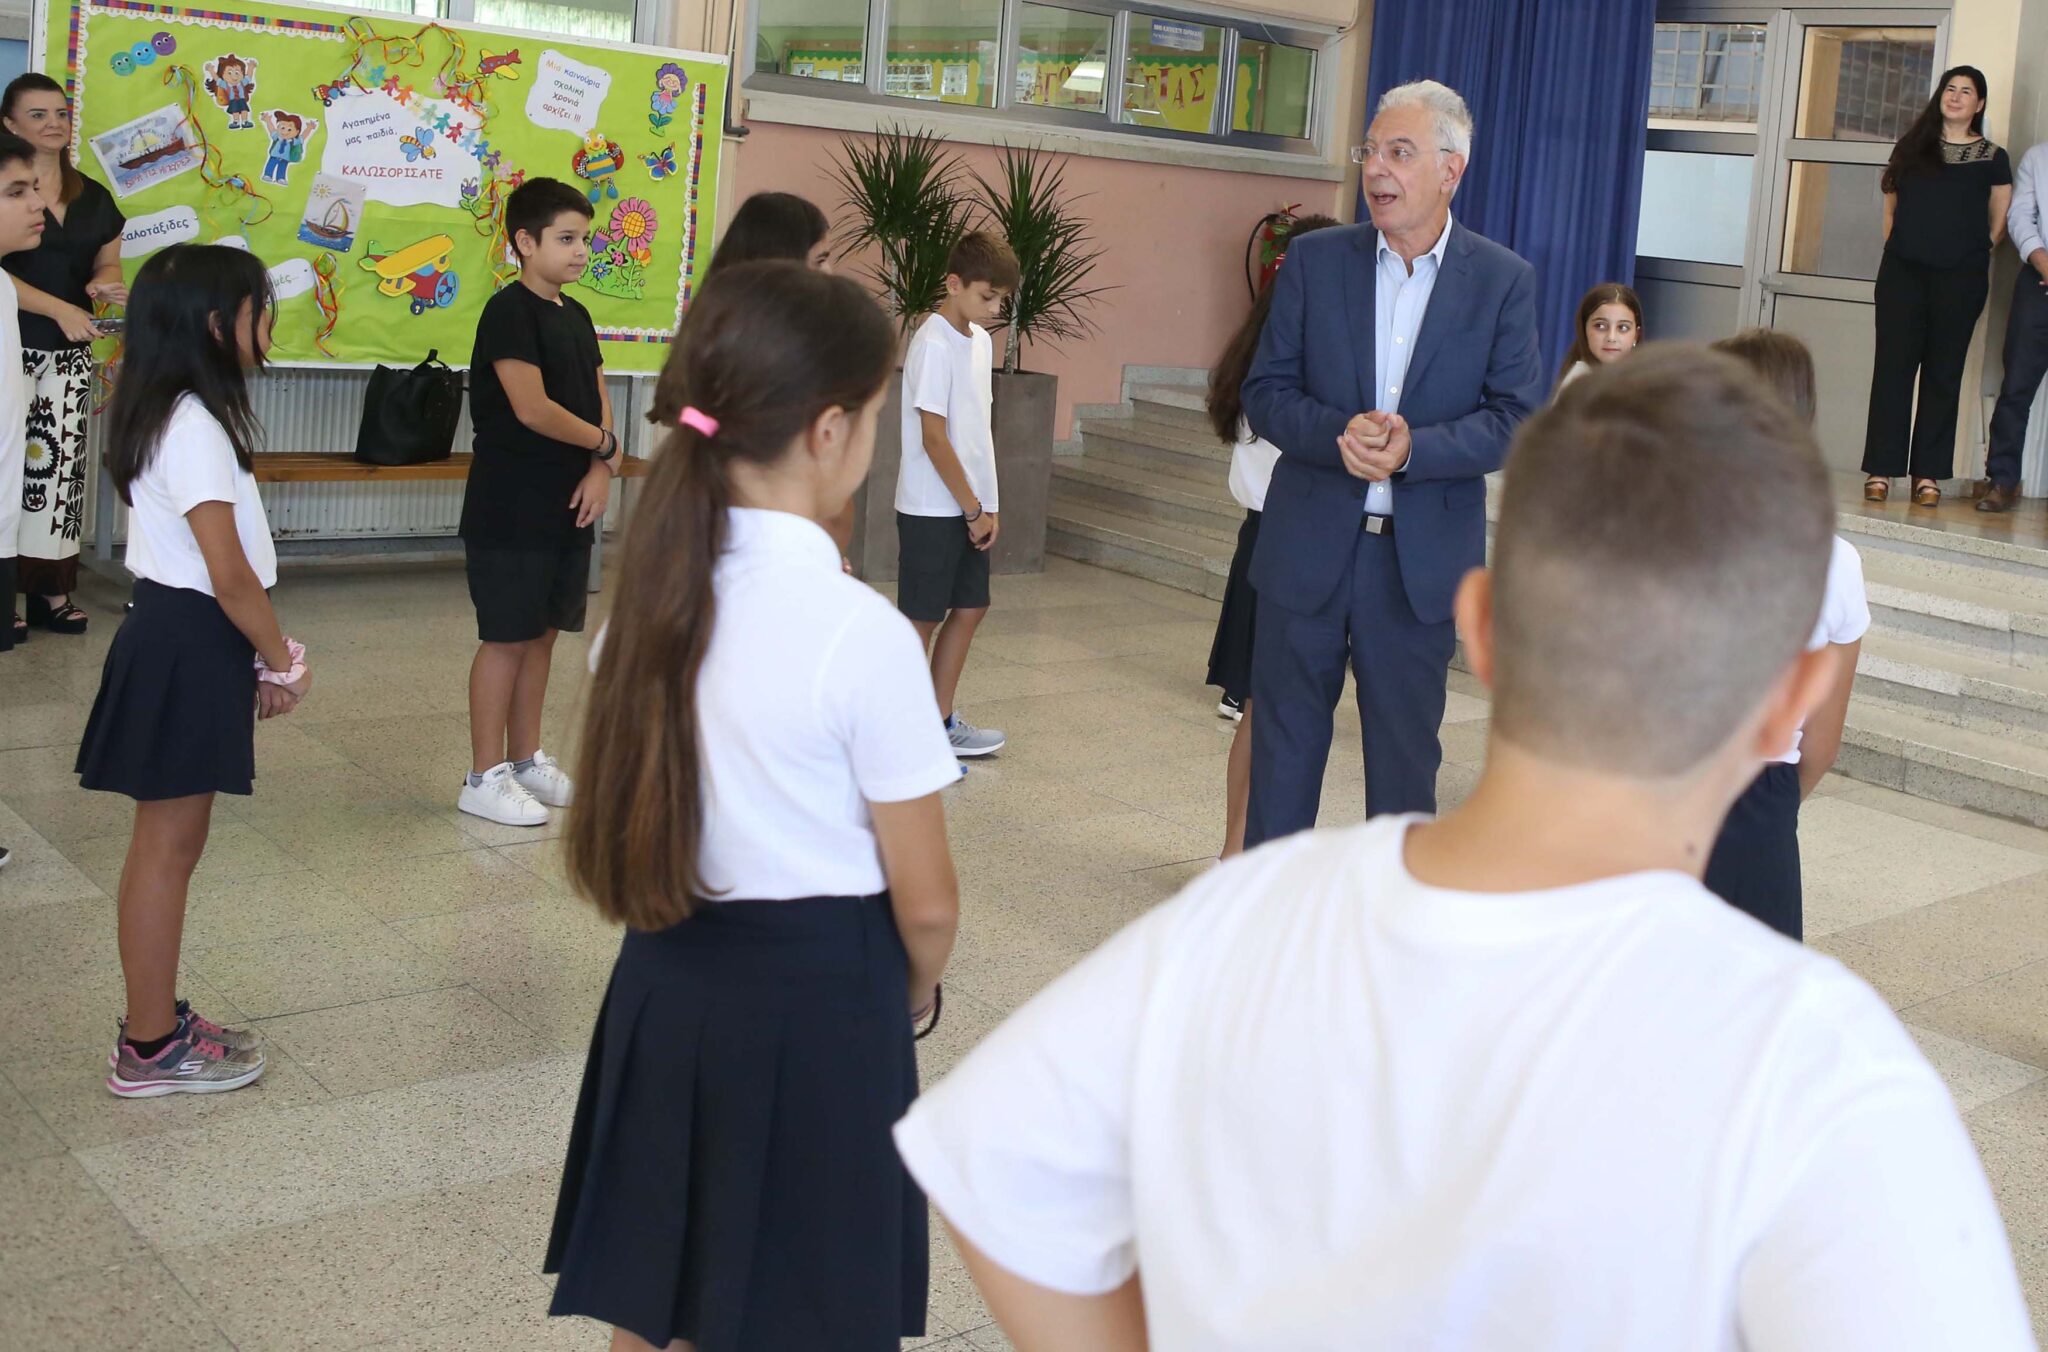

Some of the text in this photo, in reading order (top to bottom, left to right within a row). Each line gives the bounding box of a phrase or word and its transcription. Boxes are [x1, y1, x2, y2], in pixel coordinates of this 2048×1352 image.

[563, 68, 601, 89] καινούρια
[553, 79, 585, 98] σχολική
[552, 91, 580, 107] χρονιά
[542, 103, 571, 118] αρχίζει
[341, 112, 391, 129] Αγαπημένα
[345, 126, 398, 146] μας παιδιά,
[341, 164, 443, 180] ΚΑΛΩΣΟΡΙΣΑΤΕ
